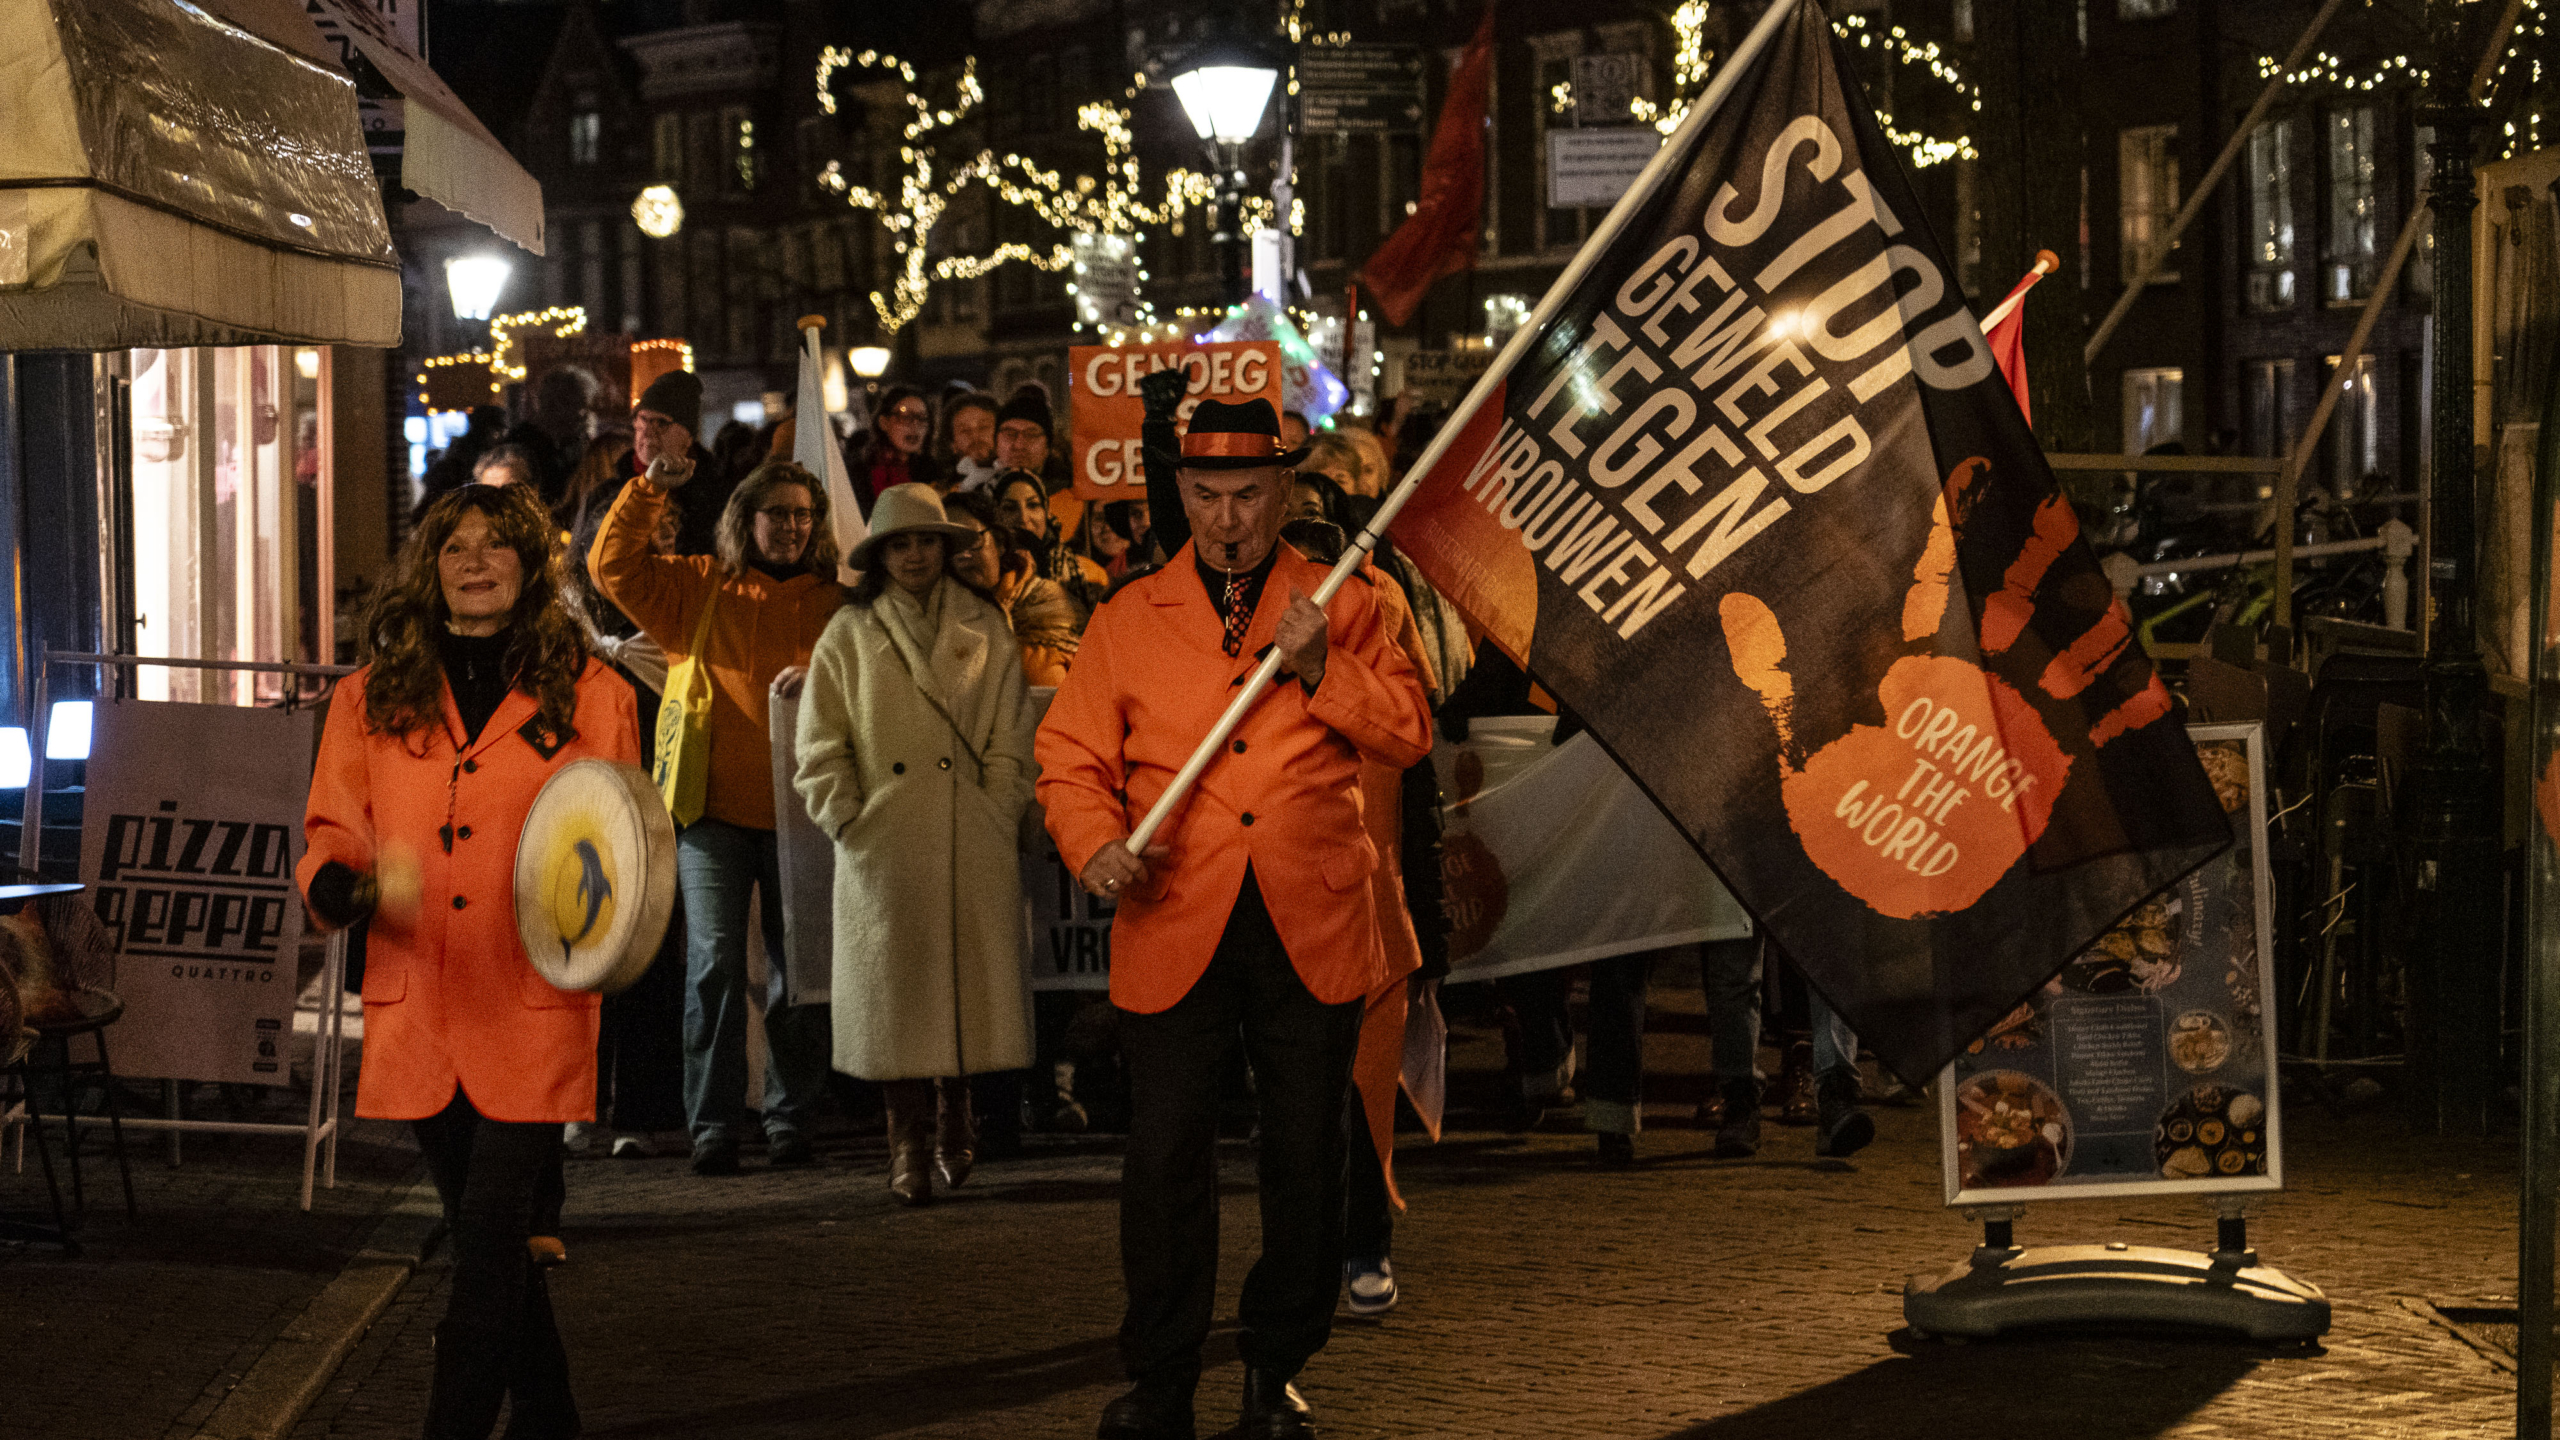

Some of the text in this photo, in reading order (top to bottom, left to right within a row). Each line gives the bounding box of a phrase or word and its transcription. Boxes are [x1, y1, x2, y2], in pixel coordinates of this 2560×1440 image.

[1704, 115, 1994, 404] STOP
[1527, 311, 1792, 580] TEGEN
[1616, 235, 1871, 494] GEWELD
[1463, 418, 1685, 640] VROUWEN
[1835, 779, 1959, 877] WORLD
[1896, 697, 2038, 812] ORANGE
[1897, 758, 1972, 827] THE
[171, 965, 273, 983] QUATTRO
